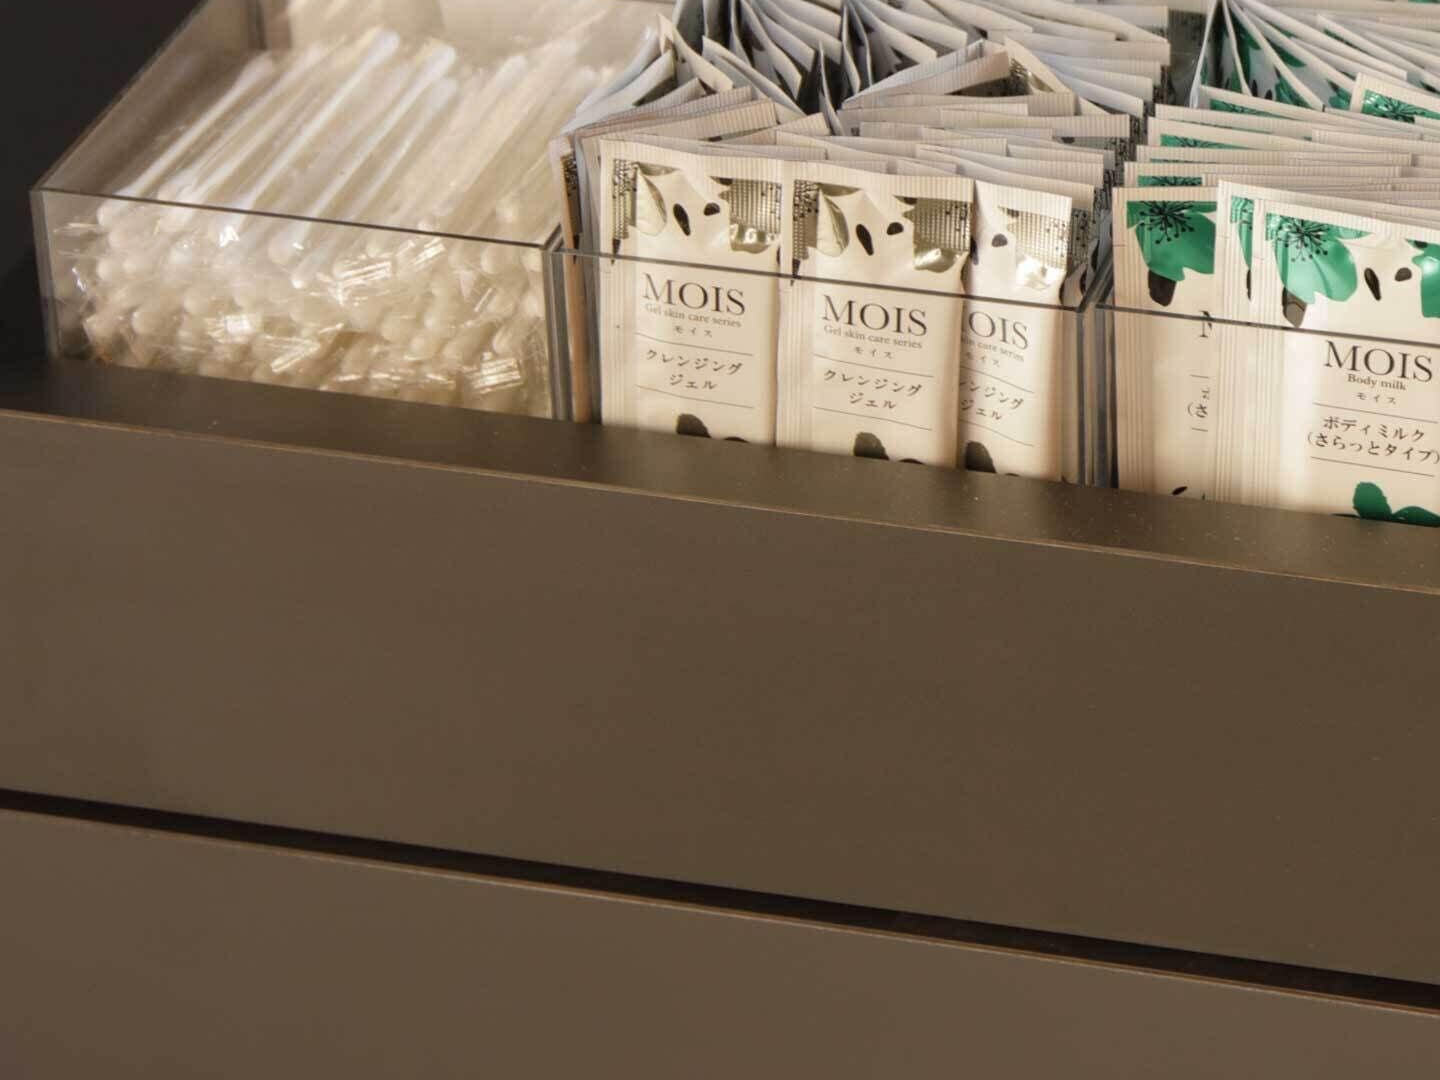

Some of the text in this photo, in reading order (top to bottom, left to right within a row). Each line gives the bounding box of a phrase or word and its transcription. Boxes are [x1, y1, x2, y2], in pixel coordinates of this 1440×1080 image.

[642, 273, 746, 317] MOIS
[687, 313, 710, 325] care
[712, 318, 743, 329] series
[821, 294, 928, 338] MOIS
[824, 325, 923, 350] Gel skin care series
[968, 311, 1029, 351] OIS
[647, 349, 743, 376] クレンジング
[1323, 339, 1433, 383] MOIS
[670, 373, 718, 390] ジェル
[823, 369, 923, 397] クレンジング
[1348, 373, 1407, 391] Body milk
[849, 392, 897, 409] ジェル
[1356, 392, 1397, 405] モイス
[1323, 416, 1425, 442] ボディミルク
